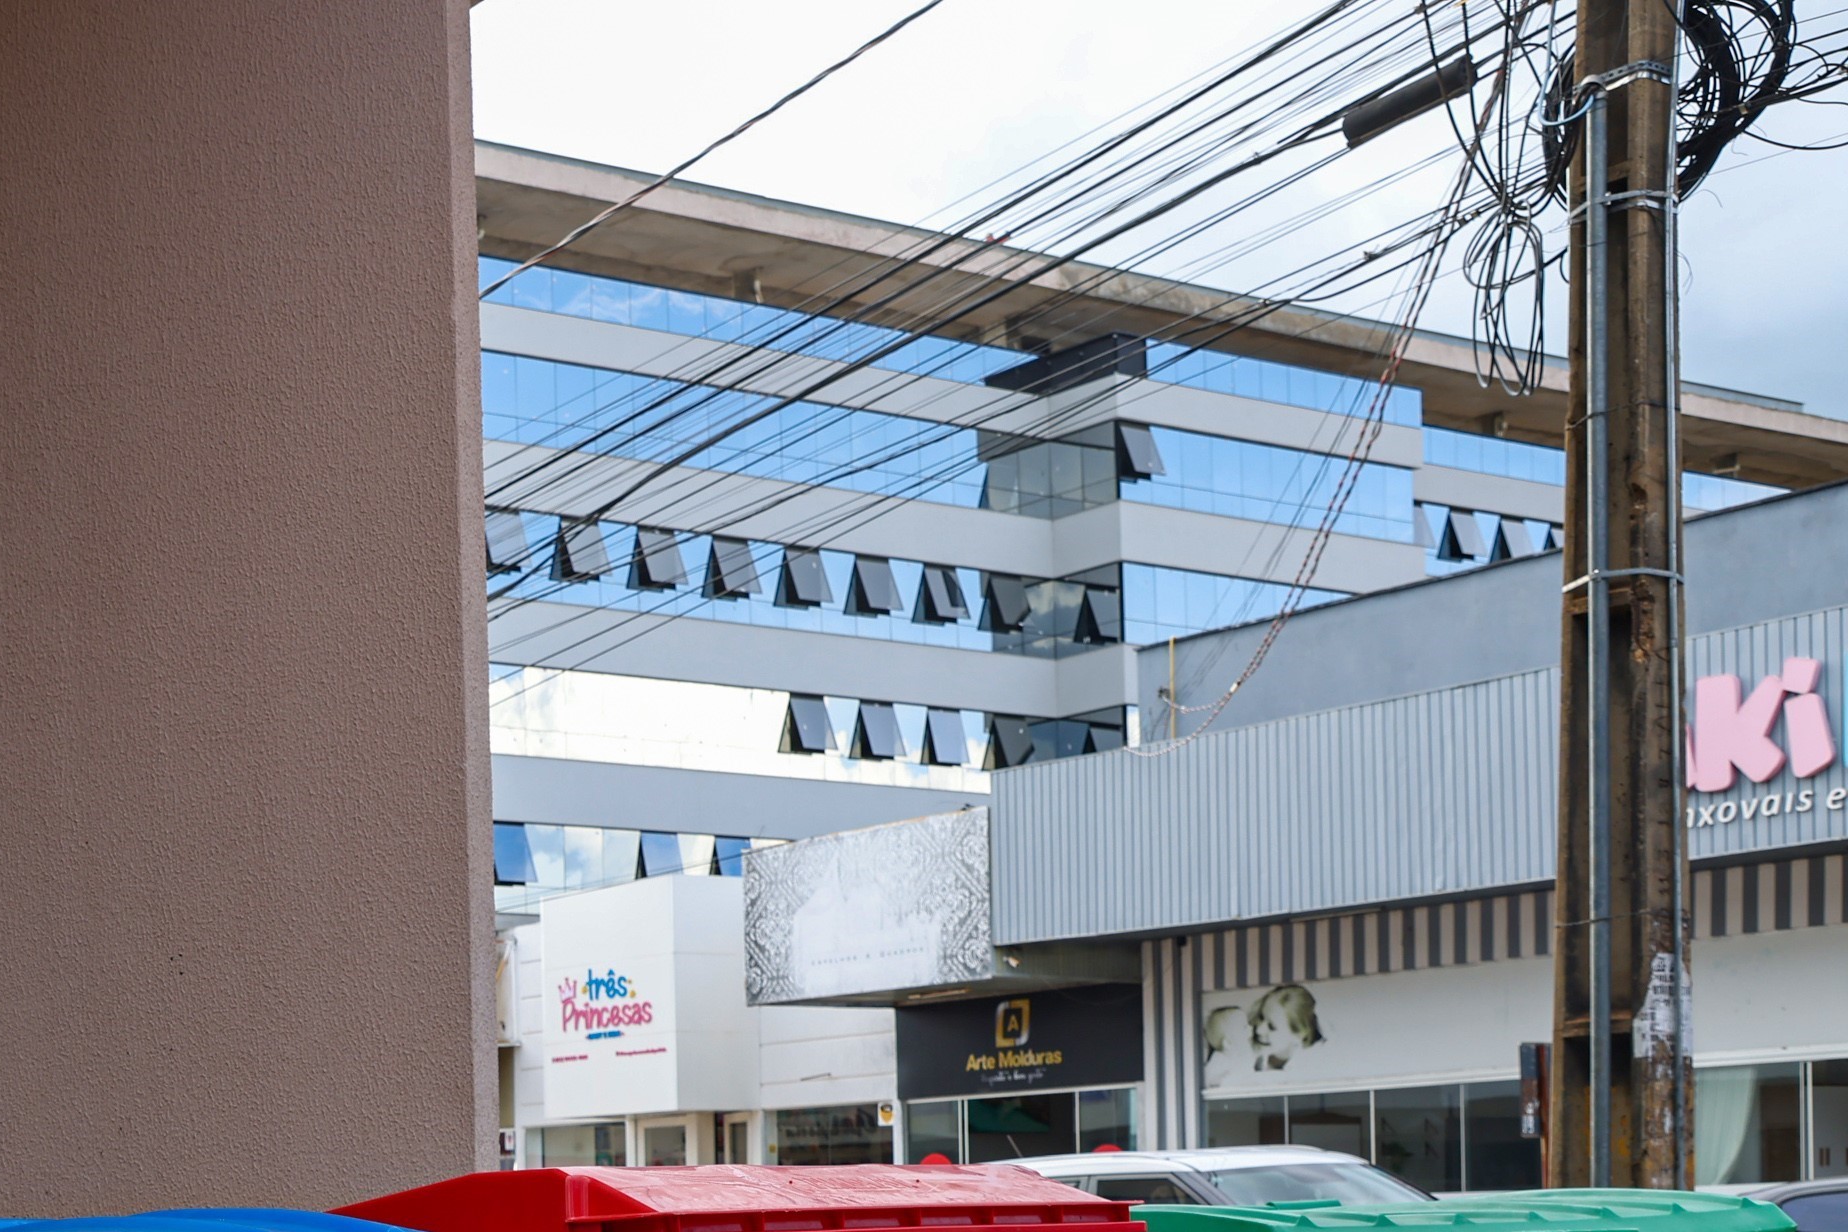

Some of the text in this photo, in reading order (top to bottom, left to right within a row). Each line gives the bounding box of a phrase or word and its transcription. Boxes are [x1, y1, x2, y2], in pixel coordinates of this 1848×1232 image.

[1686, 656, 1836, 792] Ki
[1687, 786, 1846, 828] nxovais e
[587, 968, 628, 1001] três
[562, 1000, 652, 1032] Princesas
[1007, 1015, 1019, 1031] A
[966, 1050, 1062, 1072] Arte Molduras
